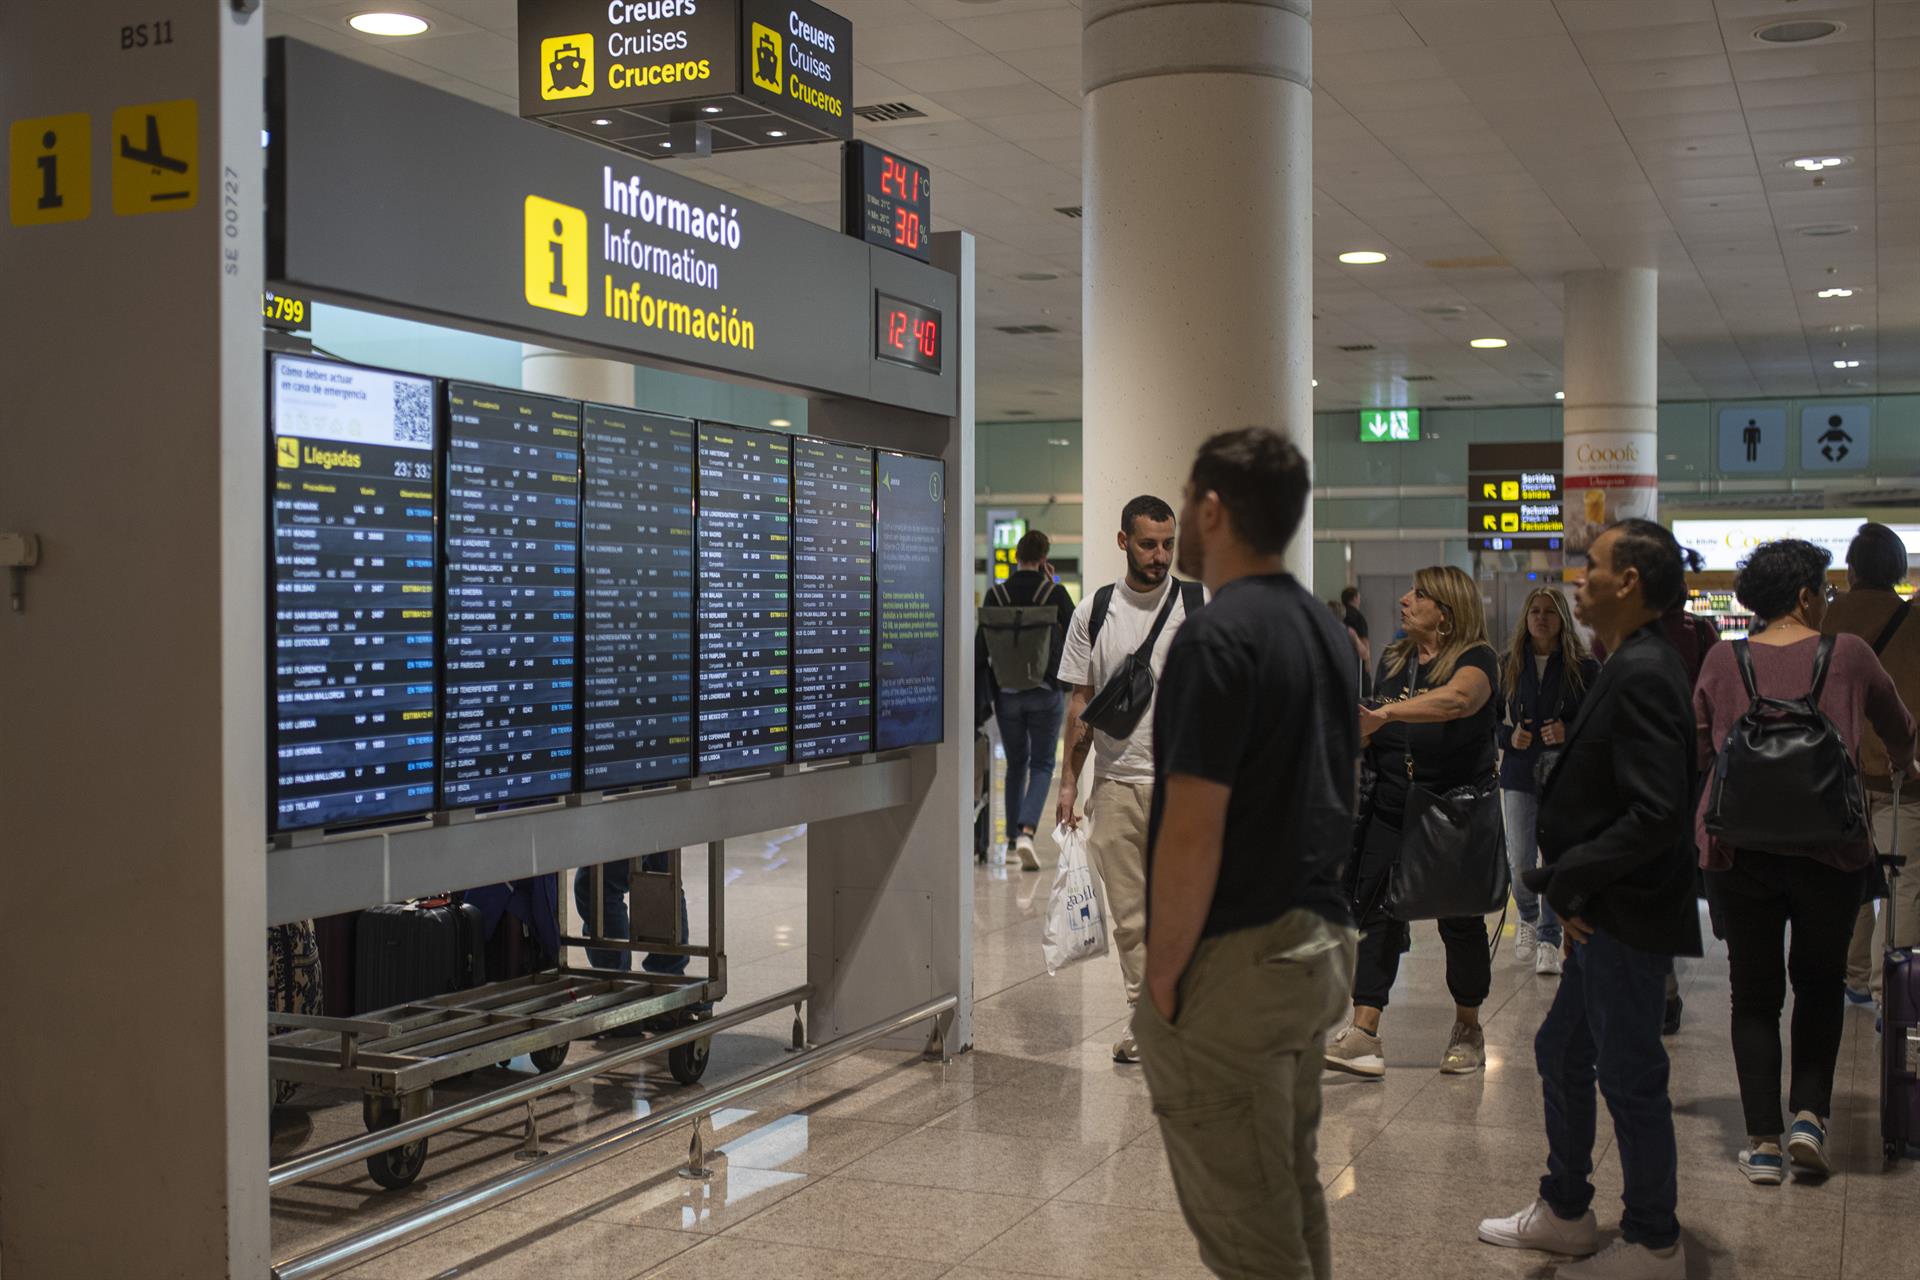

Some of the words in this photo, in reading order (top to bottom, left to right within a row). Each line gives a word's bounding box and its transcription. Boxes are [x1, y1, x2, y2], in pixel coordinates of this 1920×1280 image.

[608, 0, 696, 25] Creuers
[121, 24, 148, 50] BS
[153, 20, 173, 45] 11
[608, 30, 687, 57] Cruises
[789, 11, 836, 54] Creuers
[608, 58, 710, 89] Cruceros
[789, 42, 831, 82] Cruises
[790, 74, 842, 118] Cruceros
[225, 166, 238, 238] 00727
[604, 166, 741, 249] Informació
[896, 208, 919, 249] 30
[225, 248, 239, 276] SE
[605, 223, 718, 290] Information
[274, 296, 303, 322] 799
[605, 275, 754, 350] Información
[305, 369, 327, 382] debes
[330, 373, 353, 384] actuar
[293, 384, 310, 392] caso
[312, 384, 321, 394] de
[324, 388, 366, 400] emergencia
[304, 446, 361, 470] Llegadas
[1522, 490, 1550, 499] Salidas
